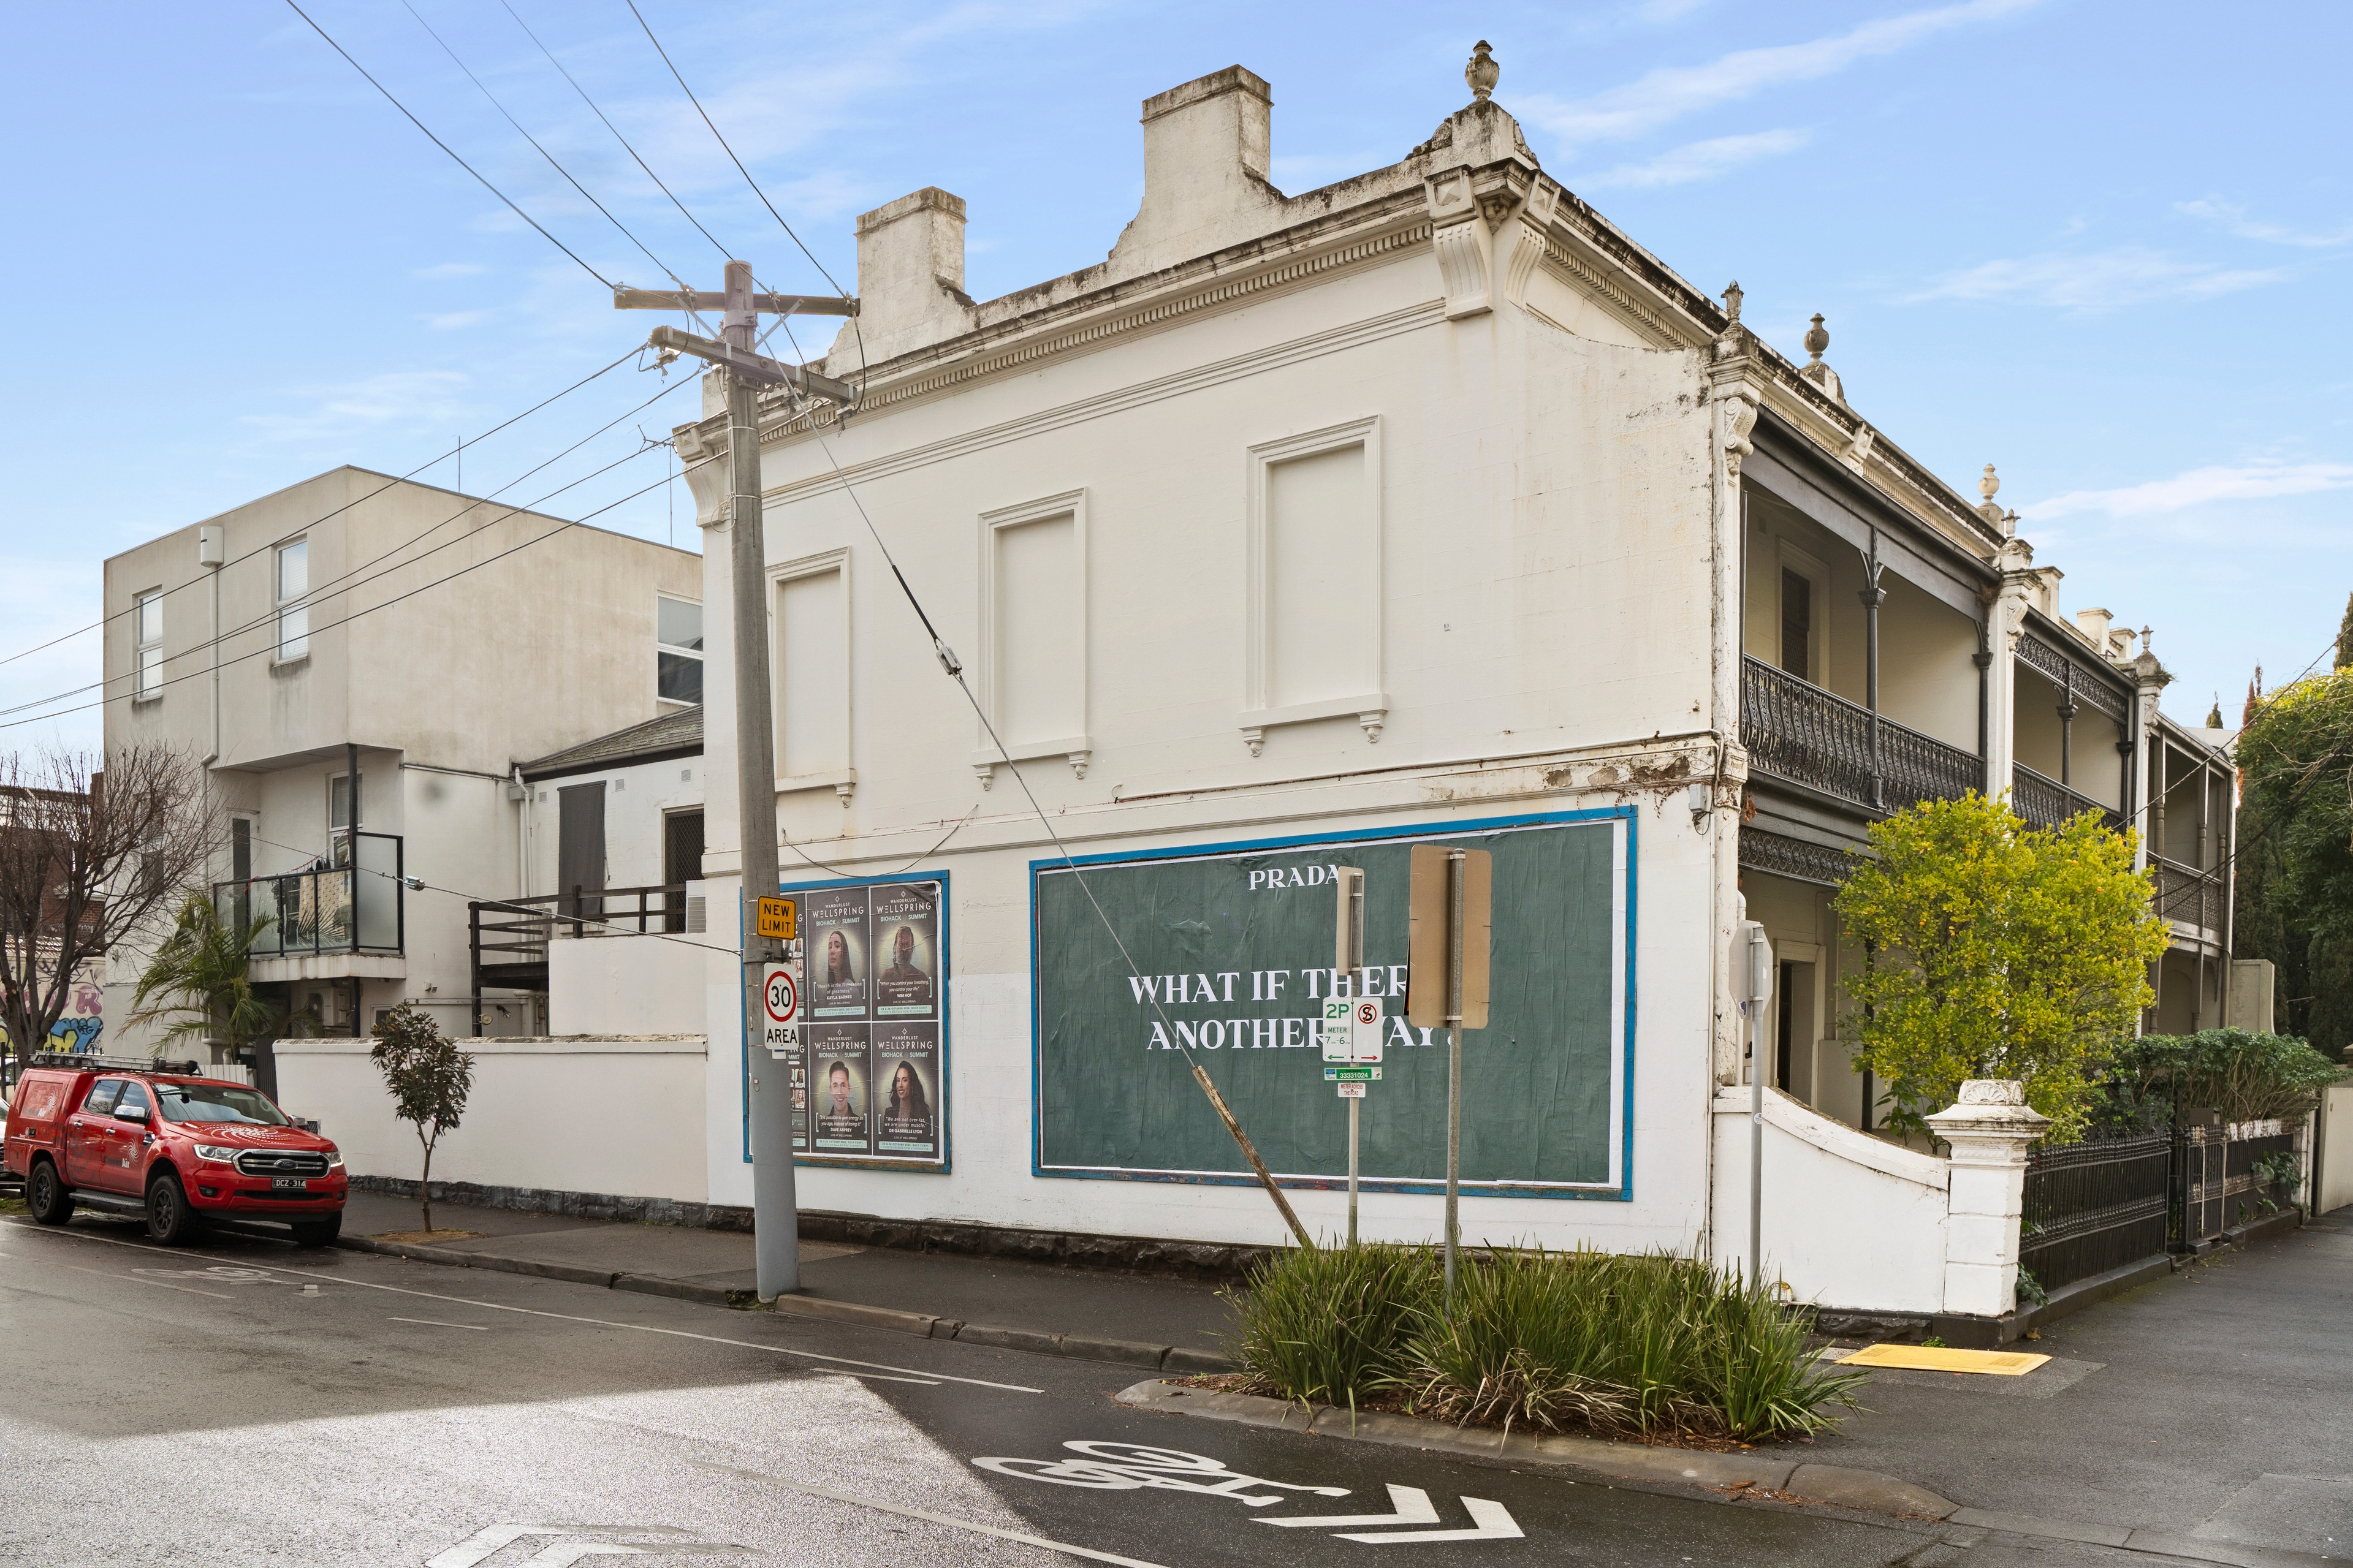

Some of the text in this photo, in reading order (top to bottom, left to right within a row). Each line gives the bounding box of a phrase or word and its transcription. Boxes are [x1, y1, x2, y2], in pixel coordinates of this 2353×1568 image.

[1249, 865, 1338, 890] PRADA
[764, 903, 789, 917] NEW
[812, 906, 864, 918] WELLSPRING
[876, 902, 931, 914] WELLSPRING
[762, 919, 791, 933] LIMIT
[1128, 965, 1407, 1004] WHAT IF THER
[771, 985, 791, 1007] 30
[1326, 1004, 1349, 1018] 2P
[766, 1028, 797, 1043] AREA
[1147, 1018, 1323, 1050] ANOTHER
